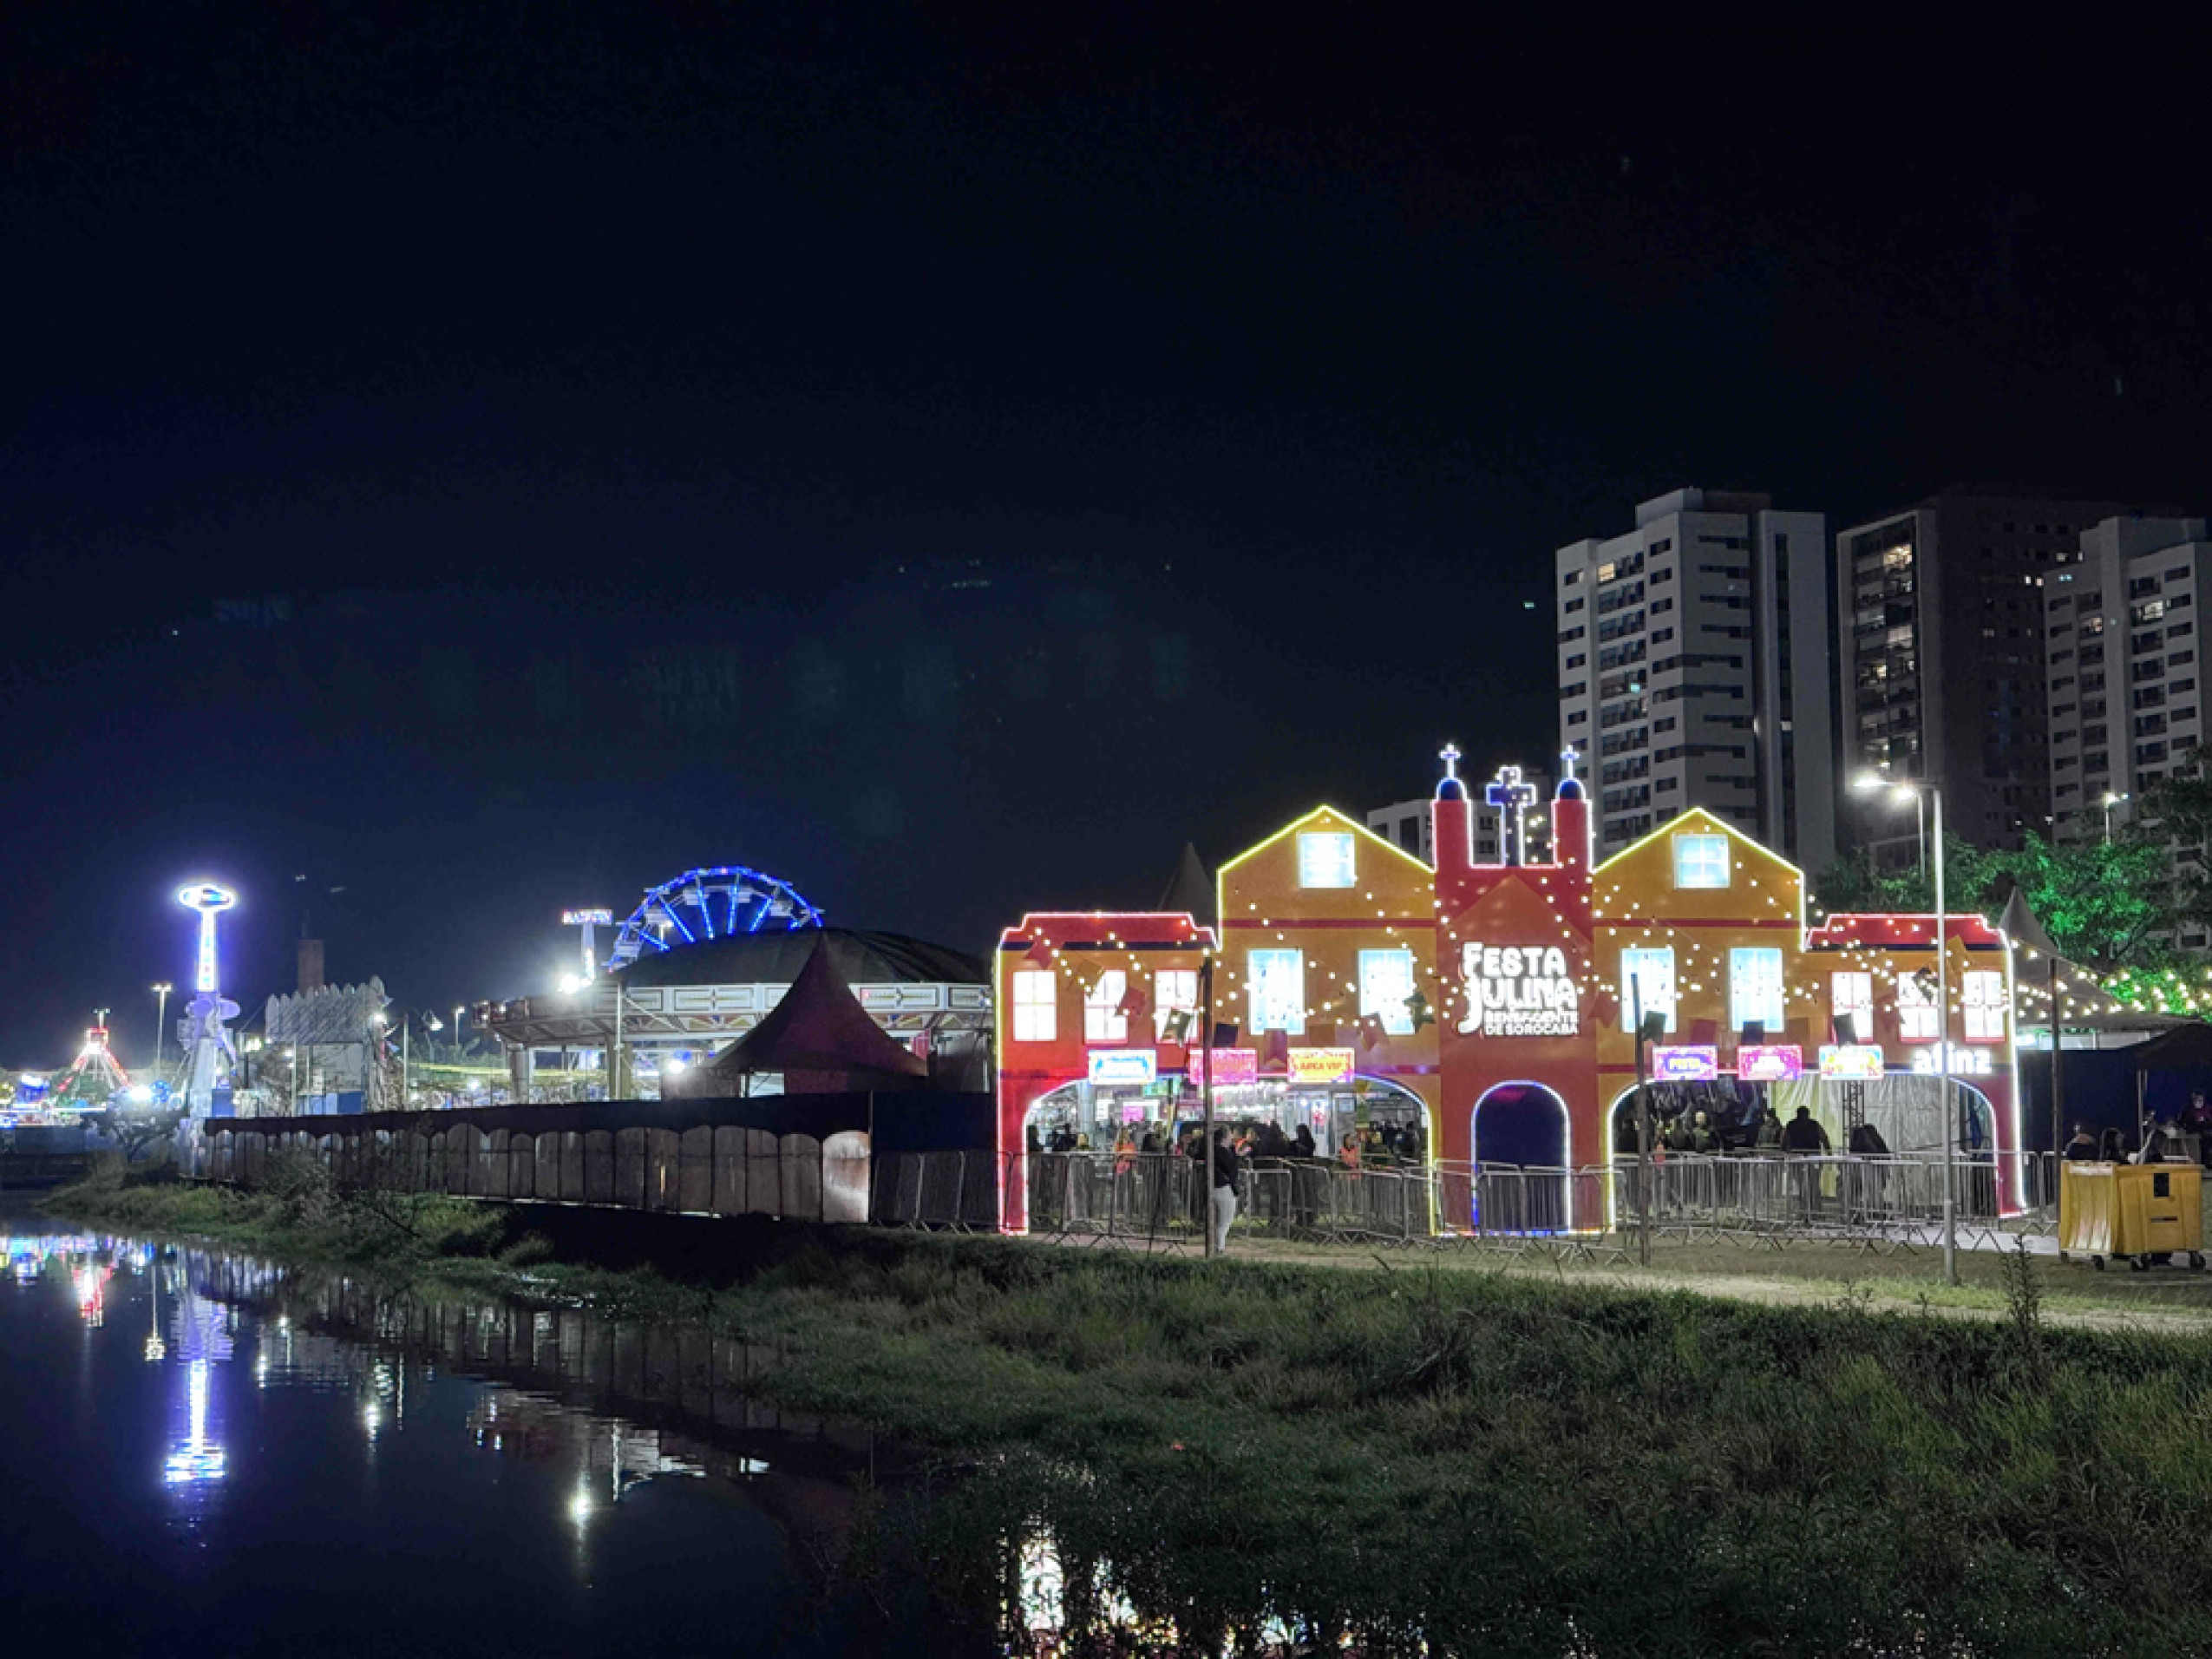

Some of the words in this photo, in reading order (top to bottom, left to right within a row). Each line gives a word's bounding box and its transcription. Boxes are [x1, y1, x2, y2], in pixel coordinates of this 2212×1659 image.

[1463, 941, 1567, 977] FESTA
[1457, 975, 1578, 1033] JULINA
[1506, 1023, 1579, 1035] SOROCABA
